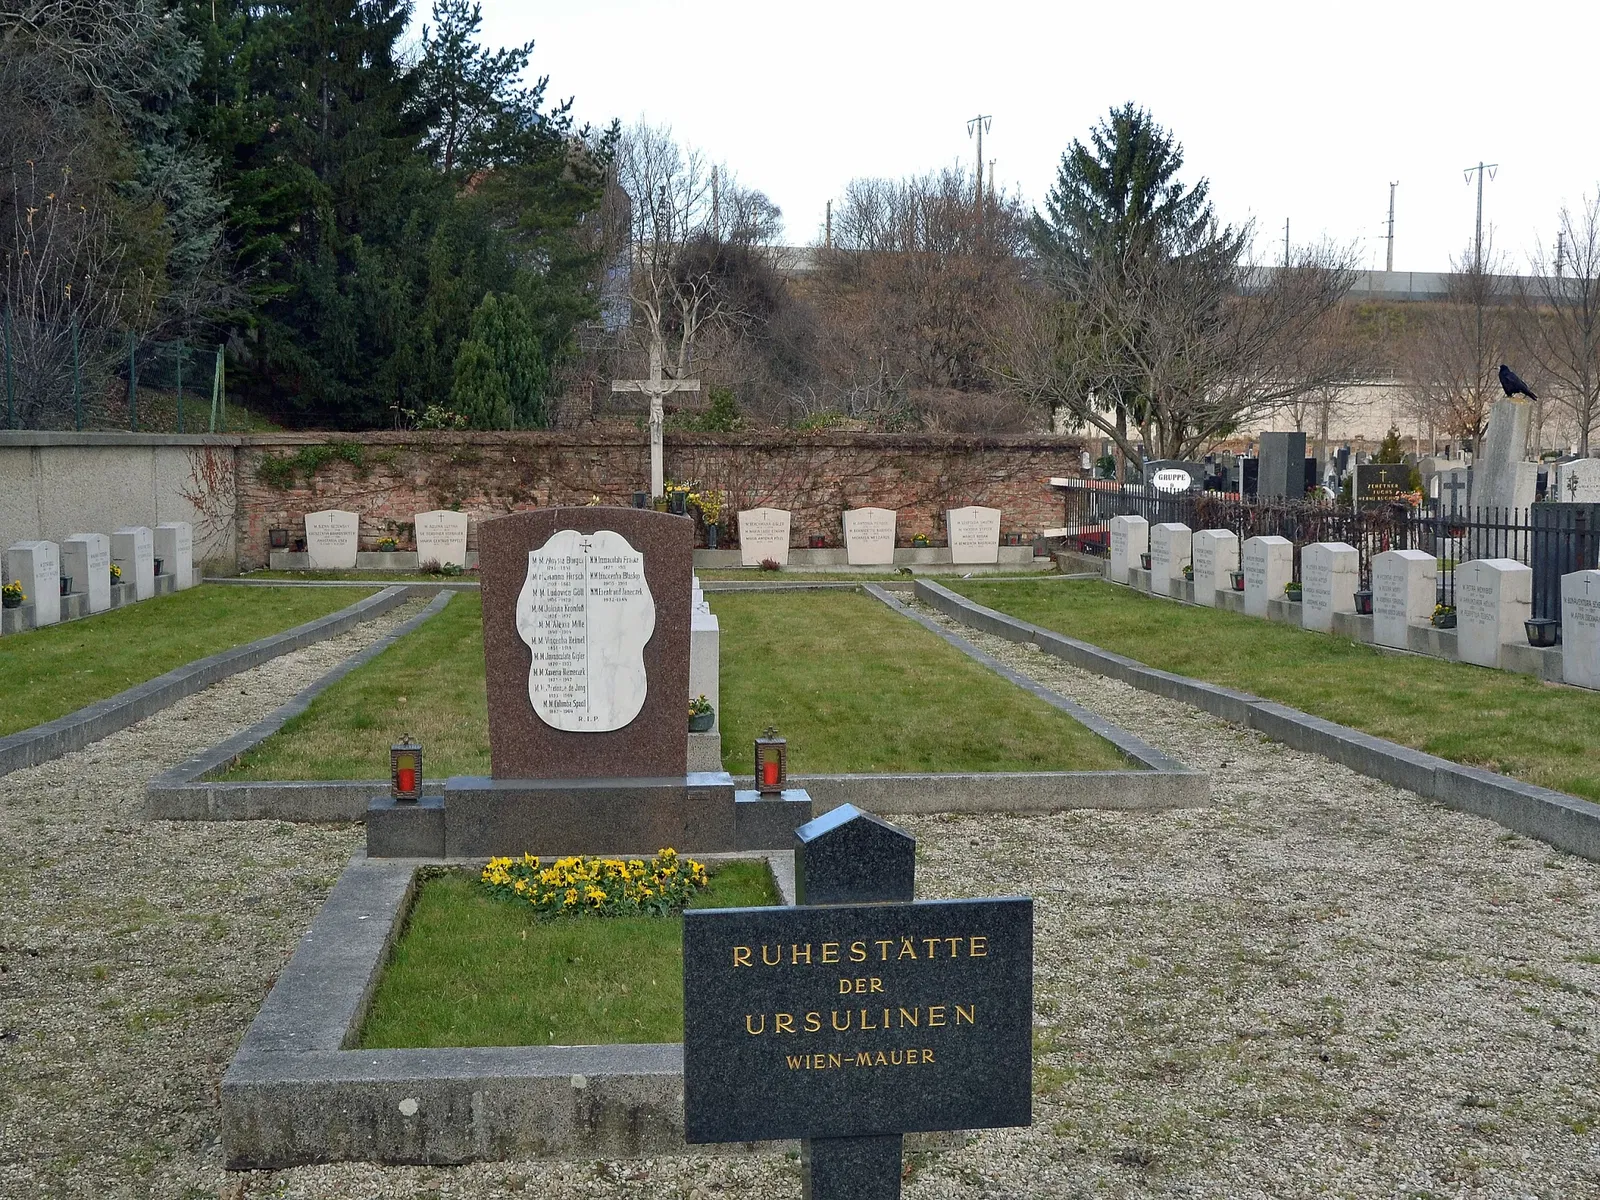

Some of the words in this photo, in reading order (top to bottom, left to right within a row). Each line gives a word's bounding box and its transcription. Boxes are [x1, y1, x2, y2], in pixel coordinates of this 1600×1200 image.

[732, 935, 989, 968] RUHESTÄTTE
[838, 977, 885, 995] DER
[745, 1003, 977, 1036] URSULINEN
[785, 1048, 936, 1071] WIEN-MAUER
